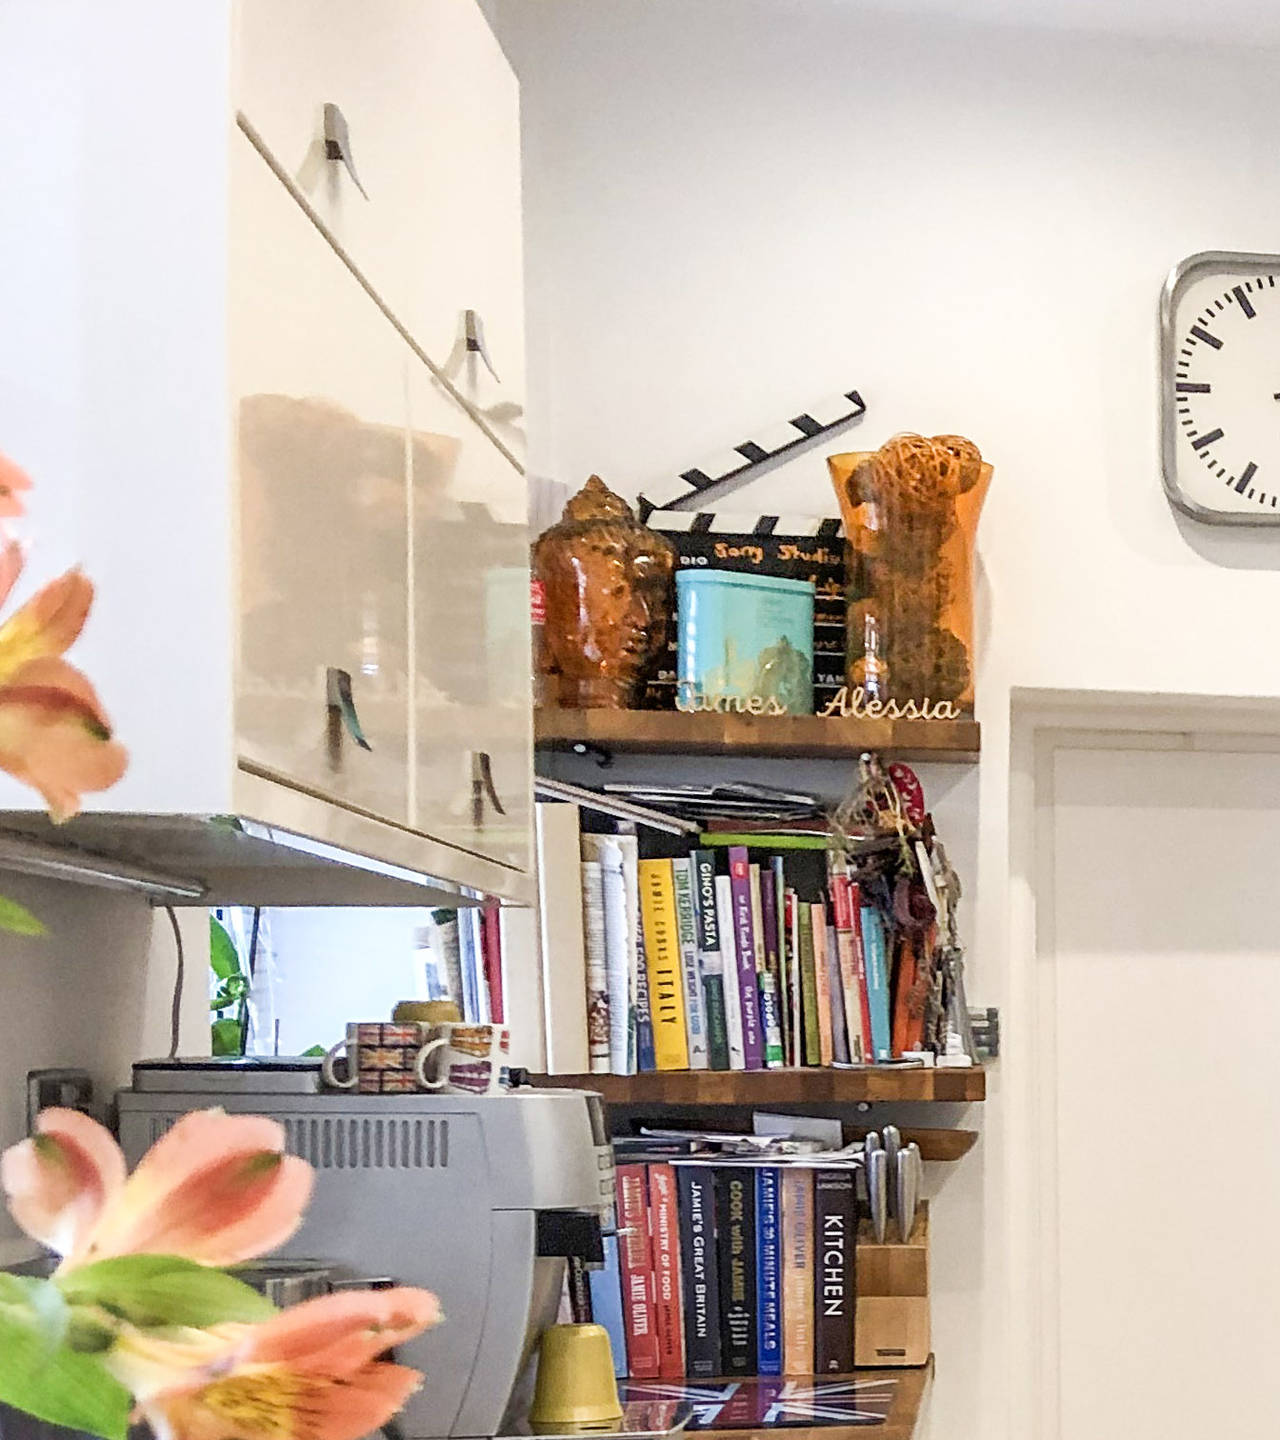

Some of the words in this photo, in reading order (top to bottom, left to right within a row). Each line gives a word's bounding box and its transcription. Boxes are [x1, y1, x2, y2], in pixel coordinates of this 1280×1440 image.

[674, 680, 788, 716] James
[816, 686, 961, 720] Alessia
[675, 869, 689, 890] TOM
[699, 863, 714, 906] GINO'S
[678, 893, 695, 945] KERRIDGE
[703, 909, 716, 945] PASTA
[656, 969, 677, 1024] ITALY
[744, 1001, 757, 1028] purple
[690, 1181, 705, 1233] JAMIE'S
[730, 1180, 743, 1221] COOK
[658, 1203, 670, 1251] MINISTRY
[731, 1224, 743, 1254] with
[795, 1222, 806, 1269] OLIVER
[661, 1254, 669, 1268] OF
[694, 1236, 705, 1281] GREAT
[823, 1214, 844, 1316] KITCHEN
[630, 1274, 646, 1302] JAMIE
[661, 1270, 671, 1300] FOOD
[731, 1258, 744, 1302] JAMIE
[632, 1303, 649, 1336] OLIVER
[695, 1284, 707, 1338] BRITAIN
[764, 1301, 776, 1350] MEALS
